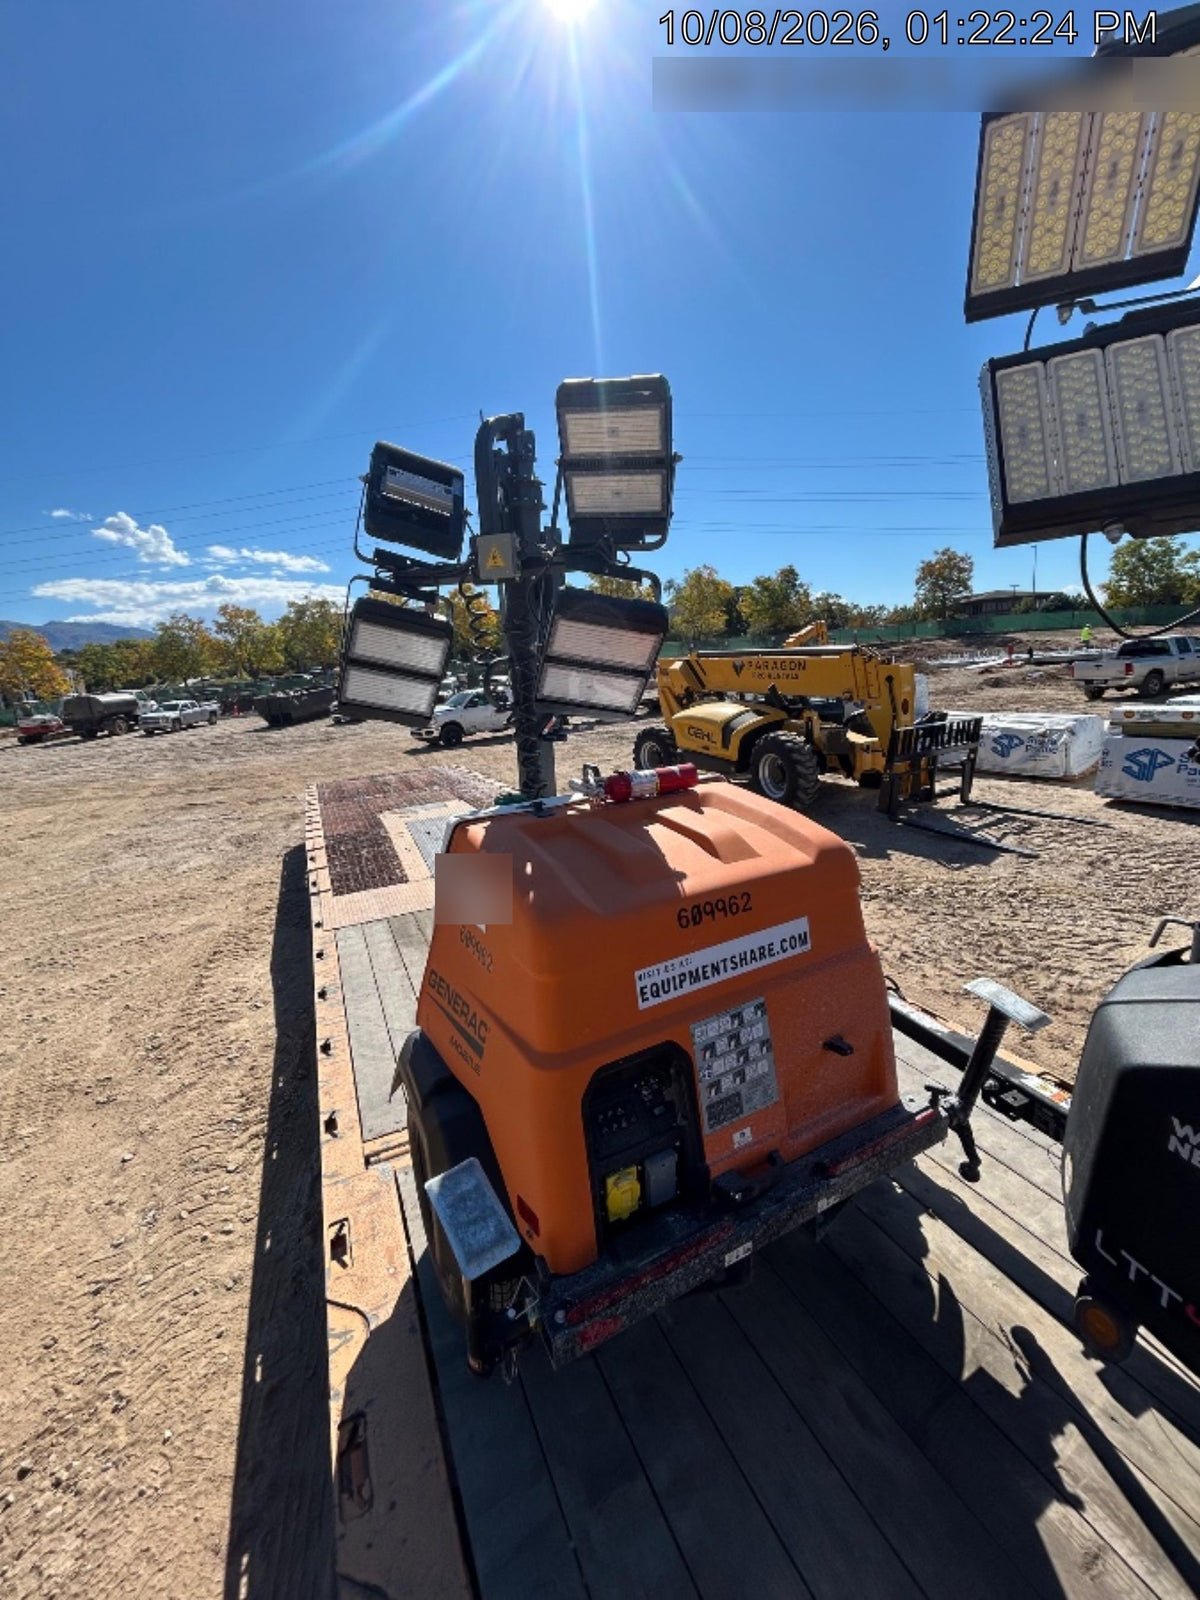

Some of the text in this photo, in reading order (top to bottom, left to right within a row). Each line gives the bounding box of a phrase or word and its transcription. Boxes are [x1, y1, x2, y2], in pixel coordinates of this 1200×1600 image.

[677, 891, 753, 929] 609962
[639, 931, 809, 1003] EQUIPMENTSHARE.COM
[428, 969, 489, 1044] GENERAC
